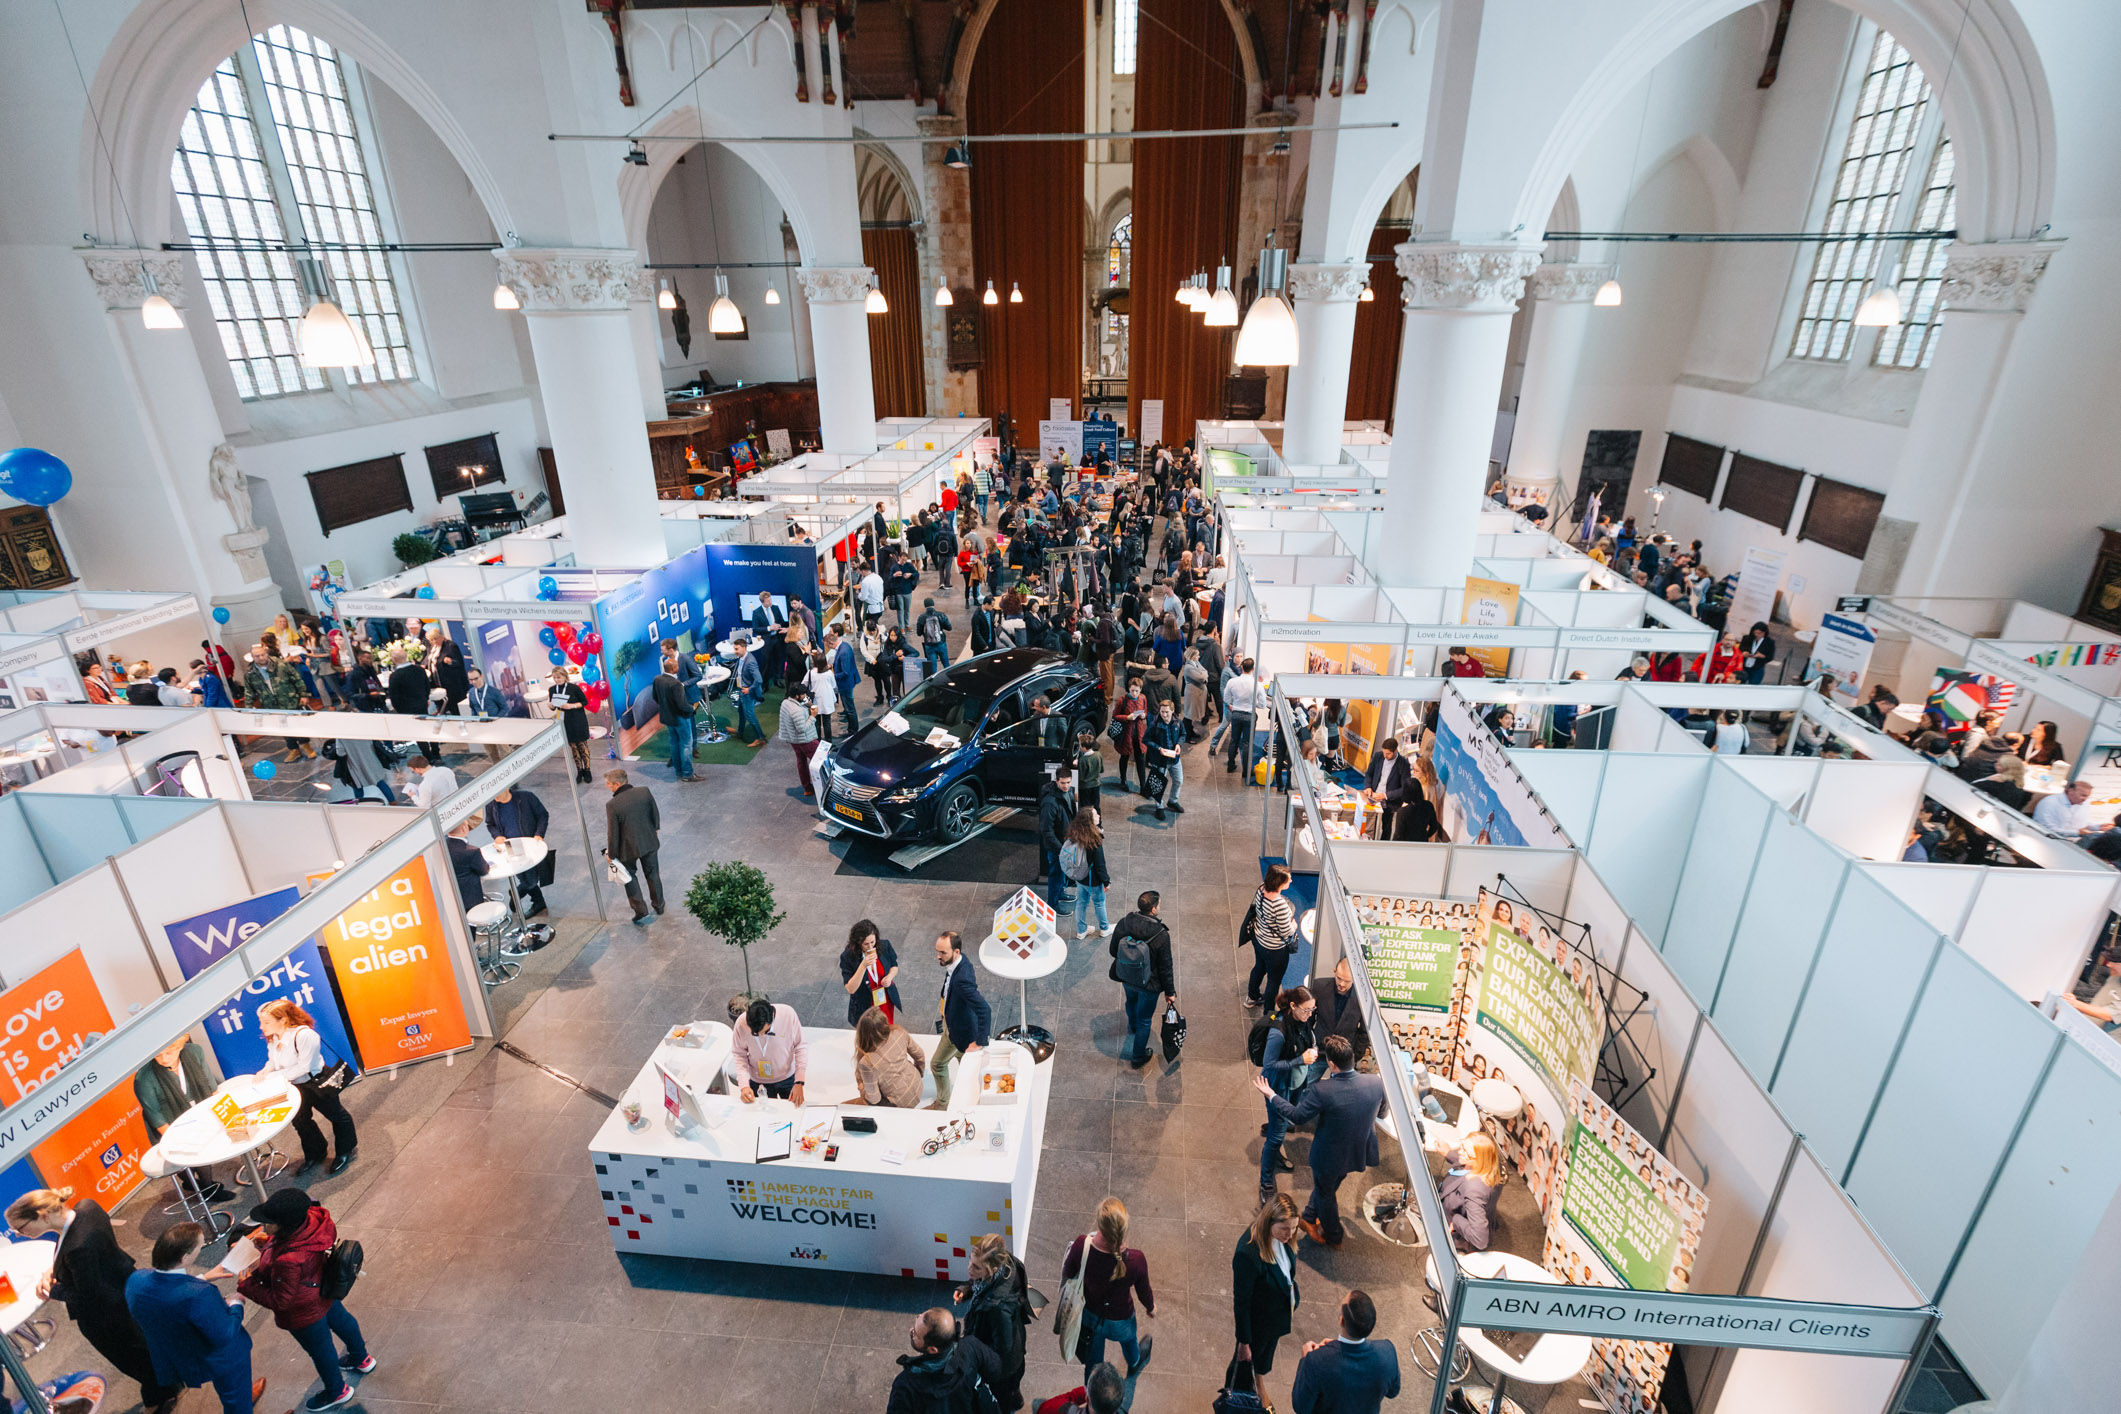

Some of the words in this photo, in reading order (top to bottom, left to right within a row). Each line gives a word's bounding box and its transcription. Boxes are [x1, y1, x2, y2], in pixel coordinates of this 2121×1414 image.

[1480, 598, 1499, 608] Love
[1480, 609, 1496, 618] Life
[76, 632, 98, 644] Eerde
[99, 618, 142, 636] International
[1271, 627, 1321, 636] in2motivation
[1417, 631, 1436, 639] Love
[1437, 631, 1452, 639] Life
[1454, 632, 1470, 640] Live
[1472, 632, 1499, 640] Awake
[1570, 634, 1594, 642] Direct
[1621, 635, 1653, 643] Institute
[438, 790, 480, 824] Blacktower
[480, 769, 511, 794] Financial
[511, 740, 551, 772] Management
[390, 878, 414, 896] a
[337, 900, 421, 941] legal
[184, 917, 262, 955] We
[1365, 938, 1384, 948] OR
[1386, 939, 1429, 951] EXPERTS
[1431, 943, 1451, 953] FOR
[1401, 930, 1423, 940] ASK
[350, 943, 428, 974] alien
[1406, 951, 1437, 962] BANK
[1410, 961, 1438, 972] WITH
[1368, 969, 1406, 979] ERVICES
[1382, 980, 1429, 991] SUPPORT
[1496, 932, 1551, 984] EXPAT?
[1550, 976, 1576, 1015] ASK
[1375, 988, 1414, 1000] NGLISH.
[1493, 954, 1527, 989] OUR
[1528, 979, 1579, 1047] EXPERTS
[218, 1008, 244, 1034] it
[380, 1014, 406, 1026] Expat
[407, 1008, 438, 1020] lawyers
[1487, 992, 1517, 1027] THE
[1489, 973, 1556, 1042] BANKING
[1556, 1032, 1569, 1062] IN
[37, 1026, 62, 1051] a
[398, 1033, 432, 1049] GMW
[20, 1071, 98, 1131] Lawyers
[62, 1146, 92, 1173] Experts
[92, 1138, 102, 1147] in
[102, 1117, 127, 1139] Family
[126, 1106, 141, 1119] law
[96, 1148, 139, 1193] GMW
[1578, 1131, 1621, 1176] EXPAT?
[1620, 1175, 1648, 1206] ASK
[1647, 1201, 1675, 1234] OUR
[761, 1182, 836, 1197] IAMEXPAT
[841, 1188, 874, 1200] FAIR
[763, 1194, 793, 1206] THE
[797, 1196, 850, 1210] HAGUE
[1576, 1145, 1626, 1200] EXPERTS
[1626, 1197, 1670, 1245] ABOUT
[730, 1203, 877, 1230] WELCOME!
[1569, 1185, 1620, 1244] SUPPORT
[1571, 1171, 1624, 1232] SERVICES
[1623, 1229, 1652, 1263] AND
[1574, 1158, 1627, 1219] BANKING
[1628, 1213, 1660, 1255] WITH
[1566, 1197, 1580, 1217] IN
[1579, 1212, 1629, 1274] ENGLISH.
[1486, 1297, 1540, 1314] ABN
[1546, 1302, 1626, 1321] AMRO
[1634, 1308, 1782, 1332] International
[1788, 1319, 1872, 1339] Clients
